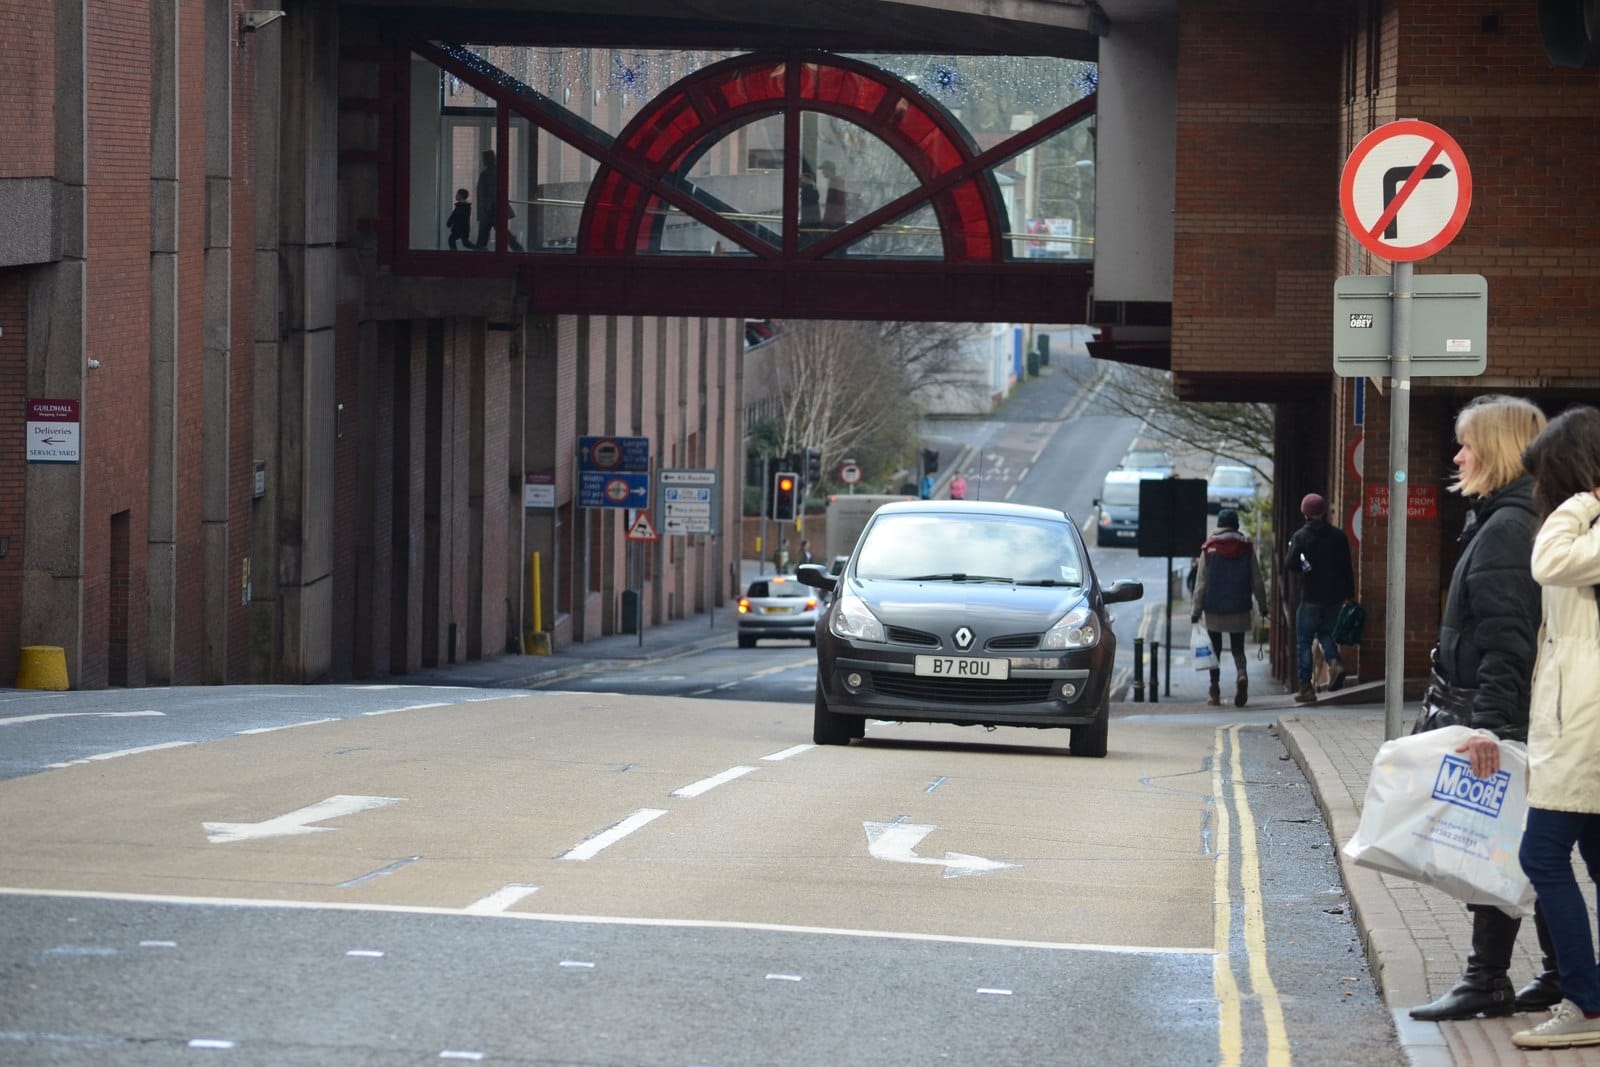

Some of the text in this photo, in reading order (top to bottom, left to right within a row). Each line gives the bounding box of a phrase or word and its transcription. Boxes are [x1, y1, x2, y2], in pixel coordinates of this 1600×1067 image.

[1350, 319, 1372, 328] OBEY
[33, 404, 73, 412] GUILDHALL
[34, 426, 72, 435] Deliveries
[1409, 497, 1434, 505] FROM
[933, 658, 990, 676] B7 ROU
[1436, 761, 1508, 809] MOORE
